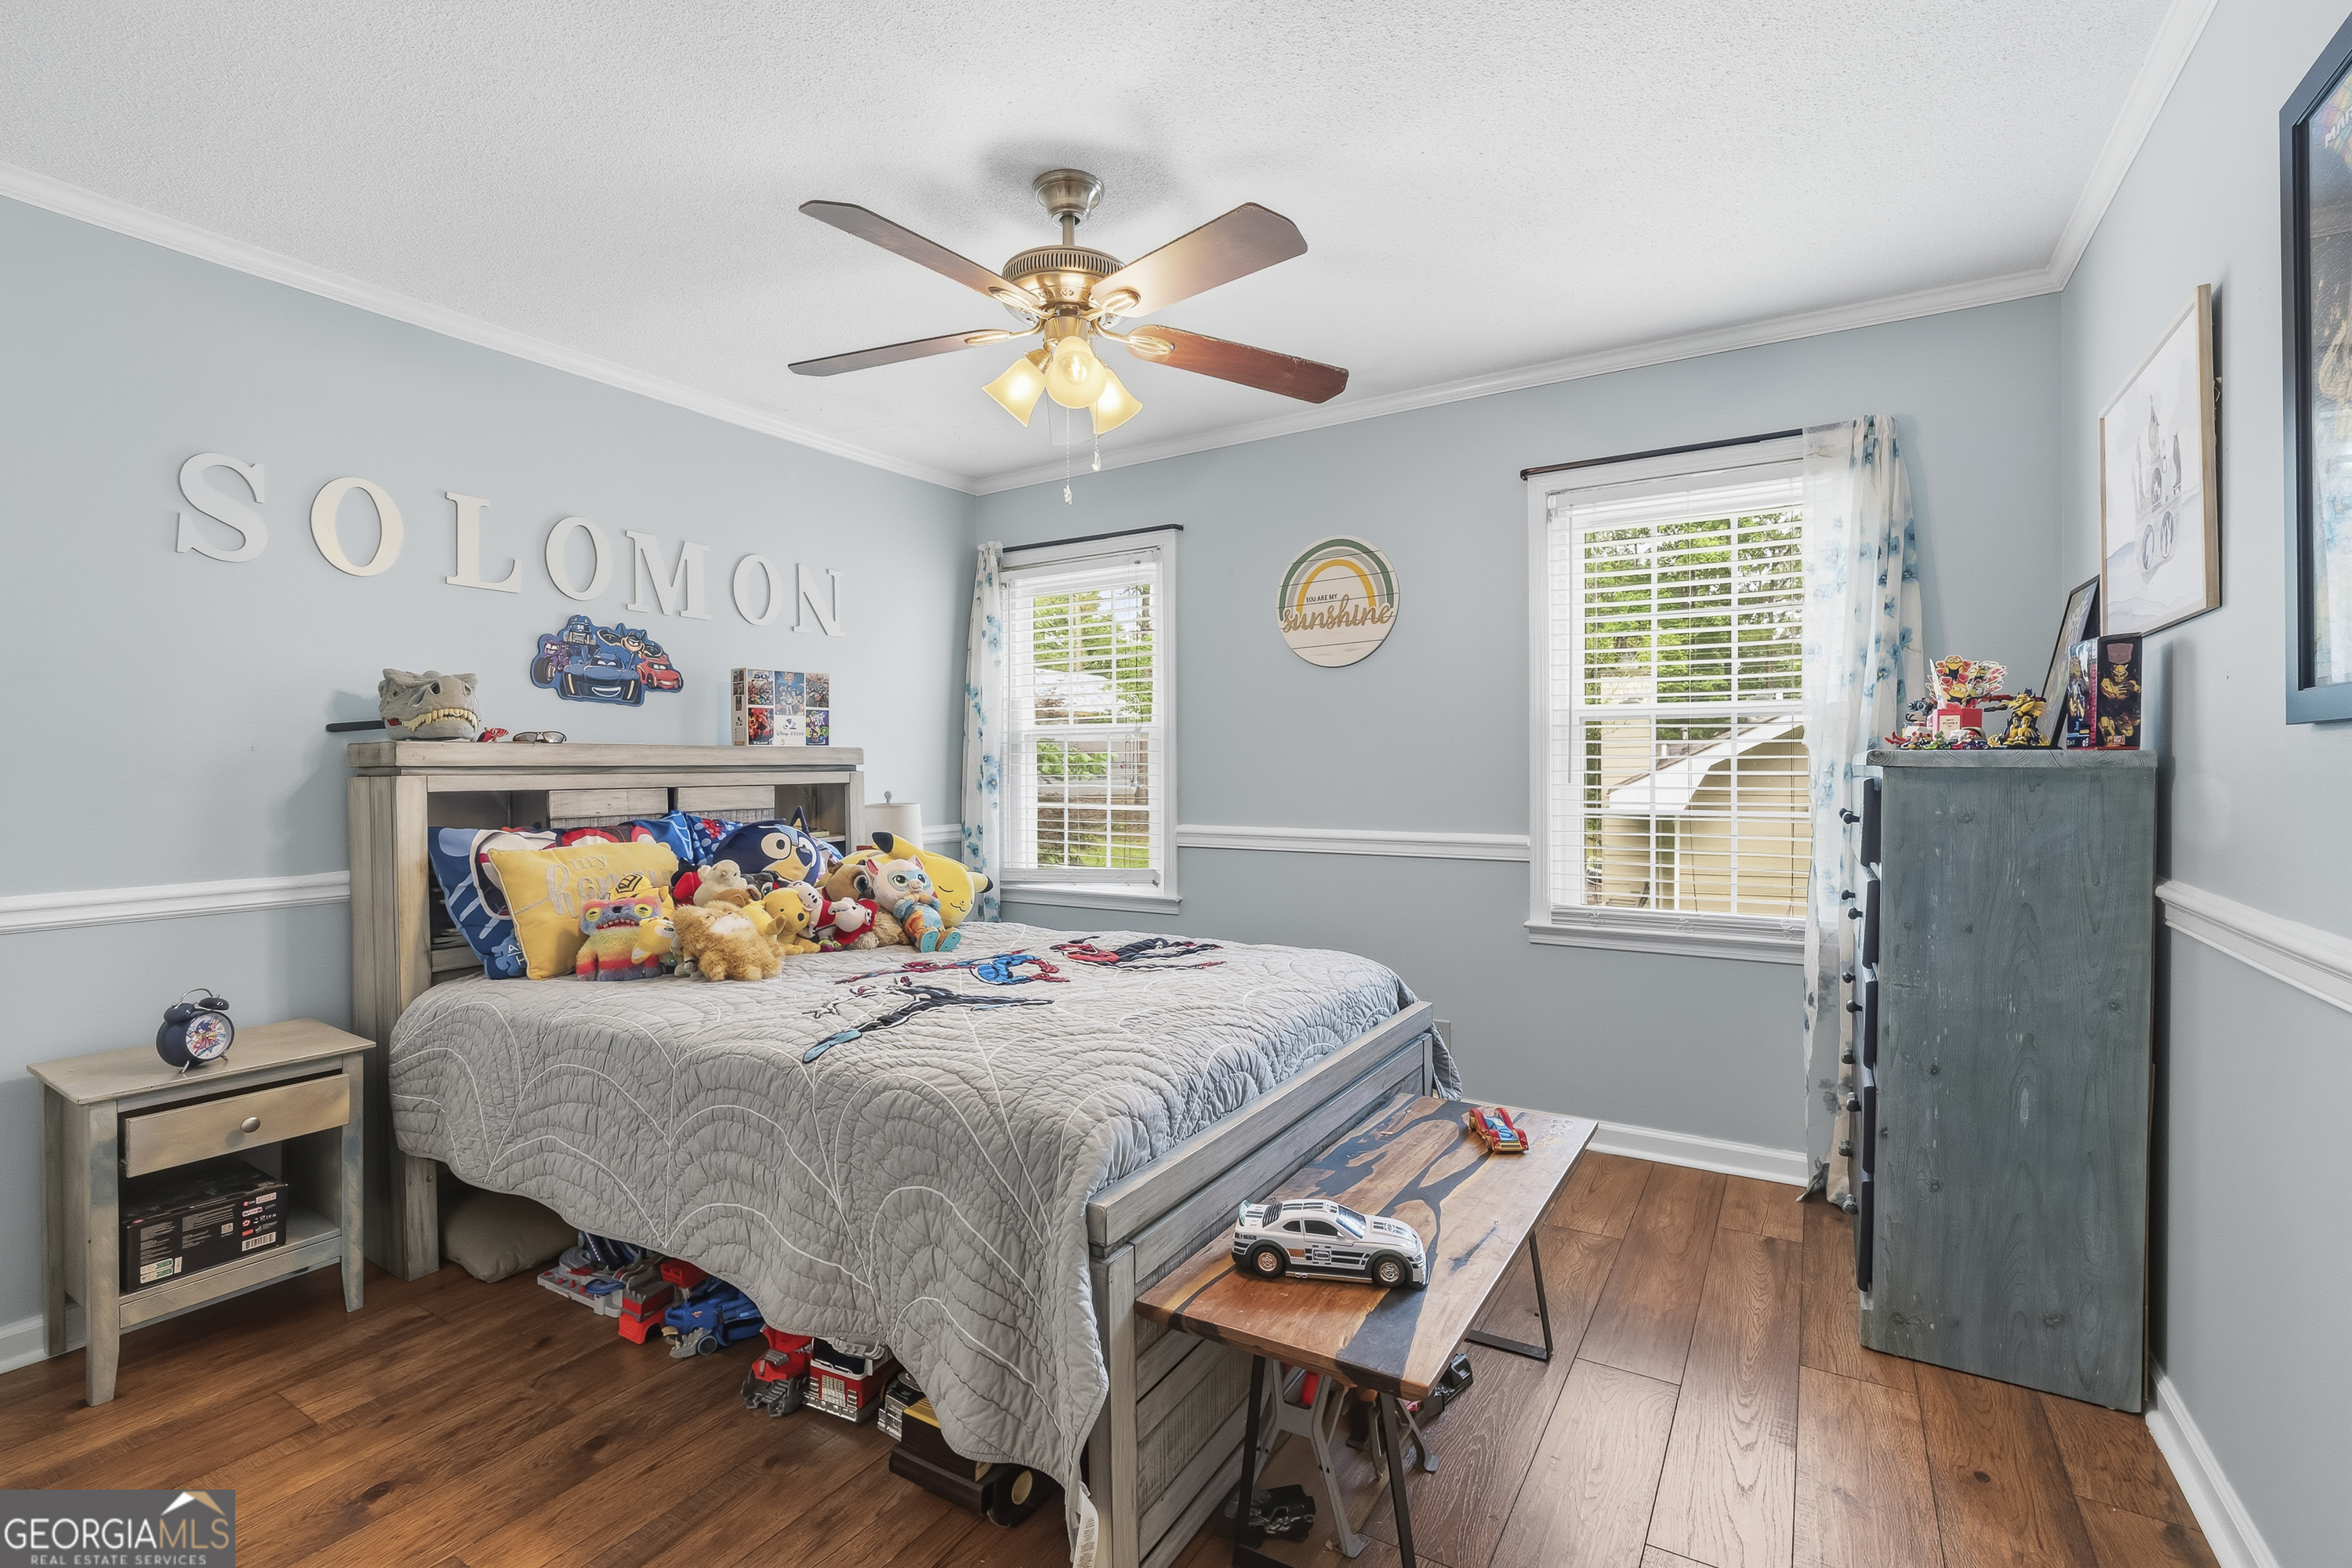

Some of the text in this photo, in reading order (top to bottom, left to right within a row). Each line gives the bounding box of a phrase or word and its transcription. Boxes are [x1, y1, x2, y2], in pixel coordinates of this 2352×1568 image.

[176, 452, 847, 637] SOLOMON
[1283, 594, 1393, 633] sunshine
[568, 855, 606, 870] my
